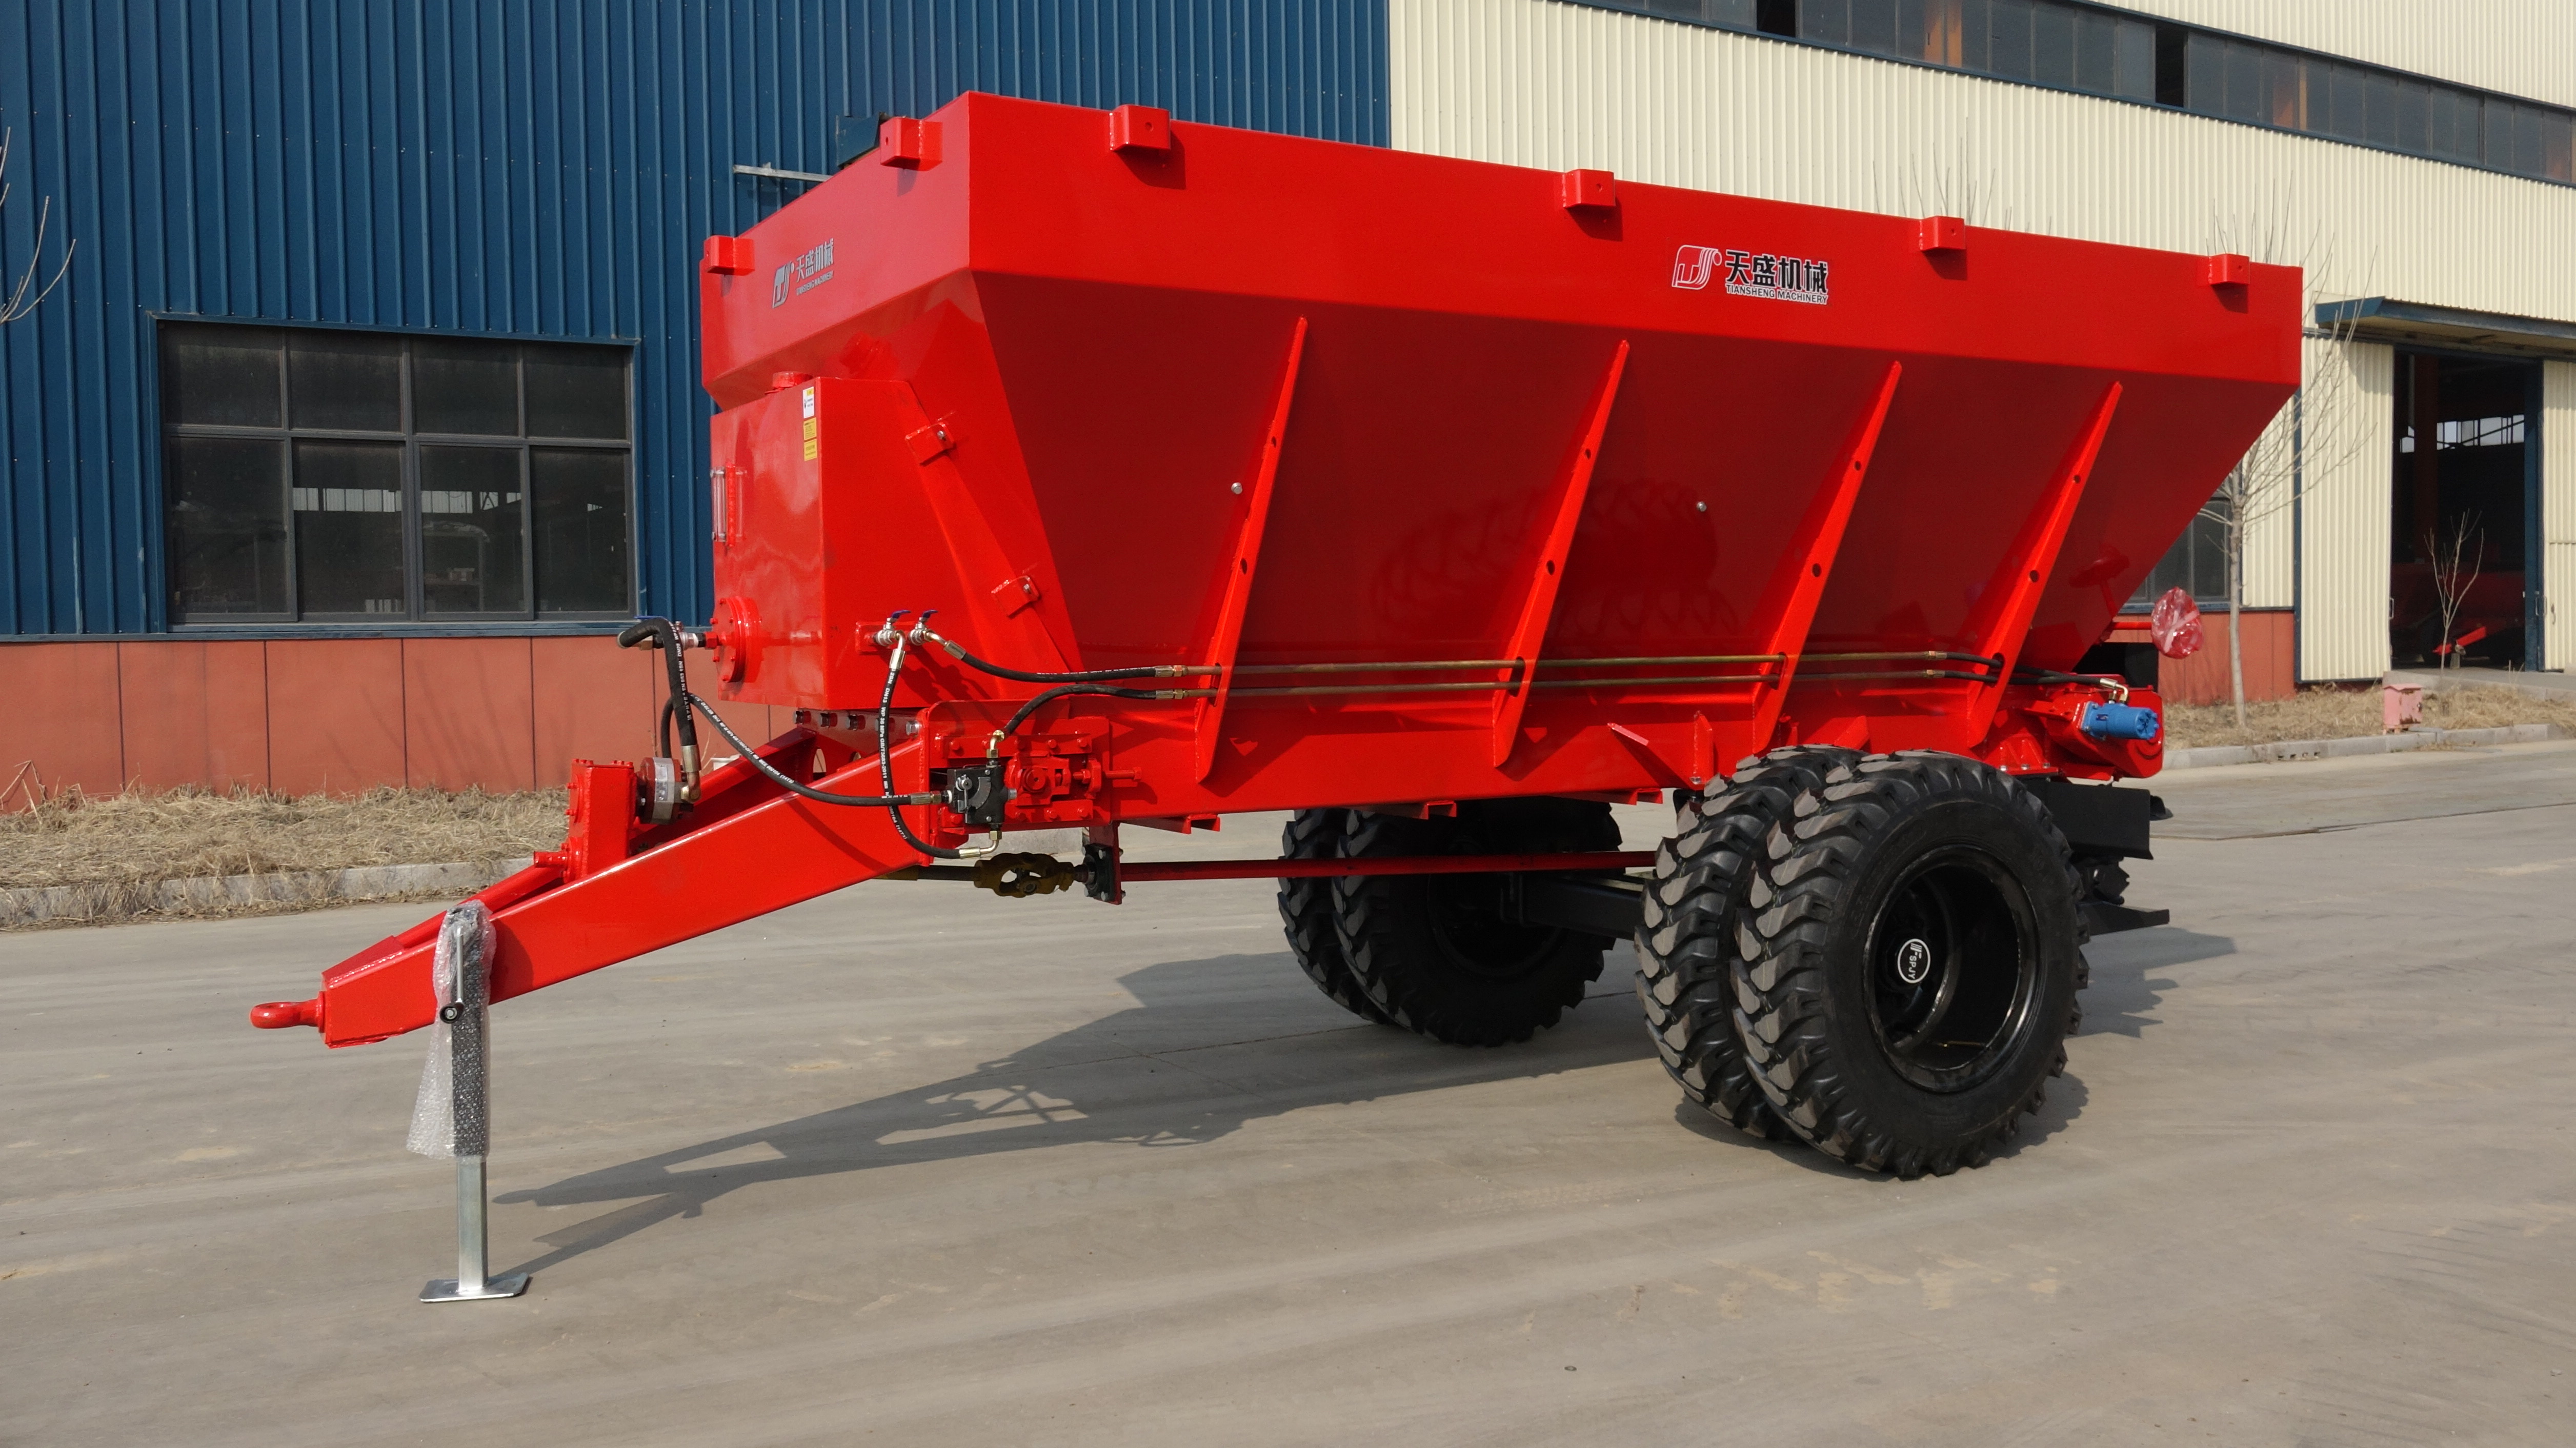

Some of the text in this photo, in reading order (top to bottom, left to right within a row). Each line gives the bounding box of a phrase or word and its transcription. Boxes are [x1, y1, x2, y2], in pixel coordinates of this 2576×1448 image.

[1725, 249, 1828, 293] 天盛机械
[1725, 284, 1828, 305] TIANSHENG MACHINERY
[881, 707, 886, 717] WP
